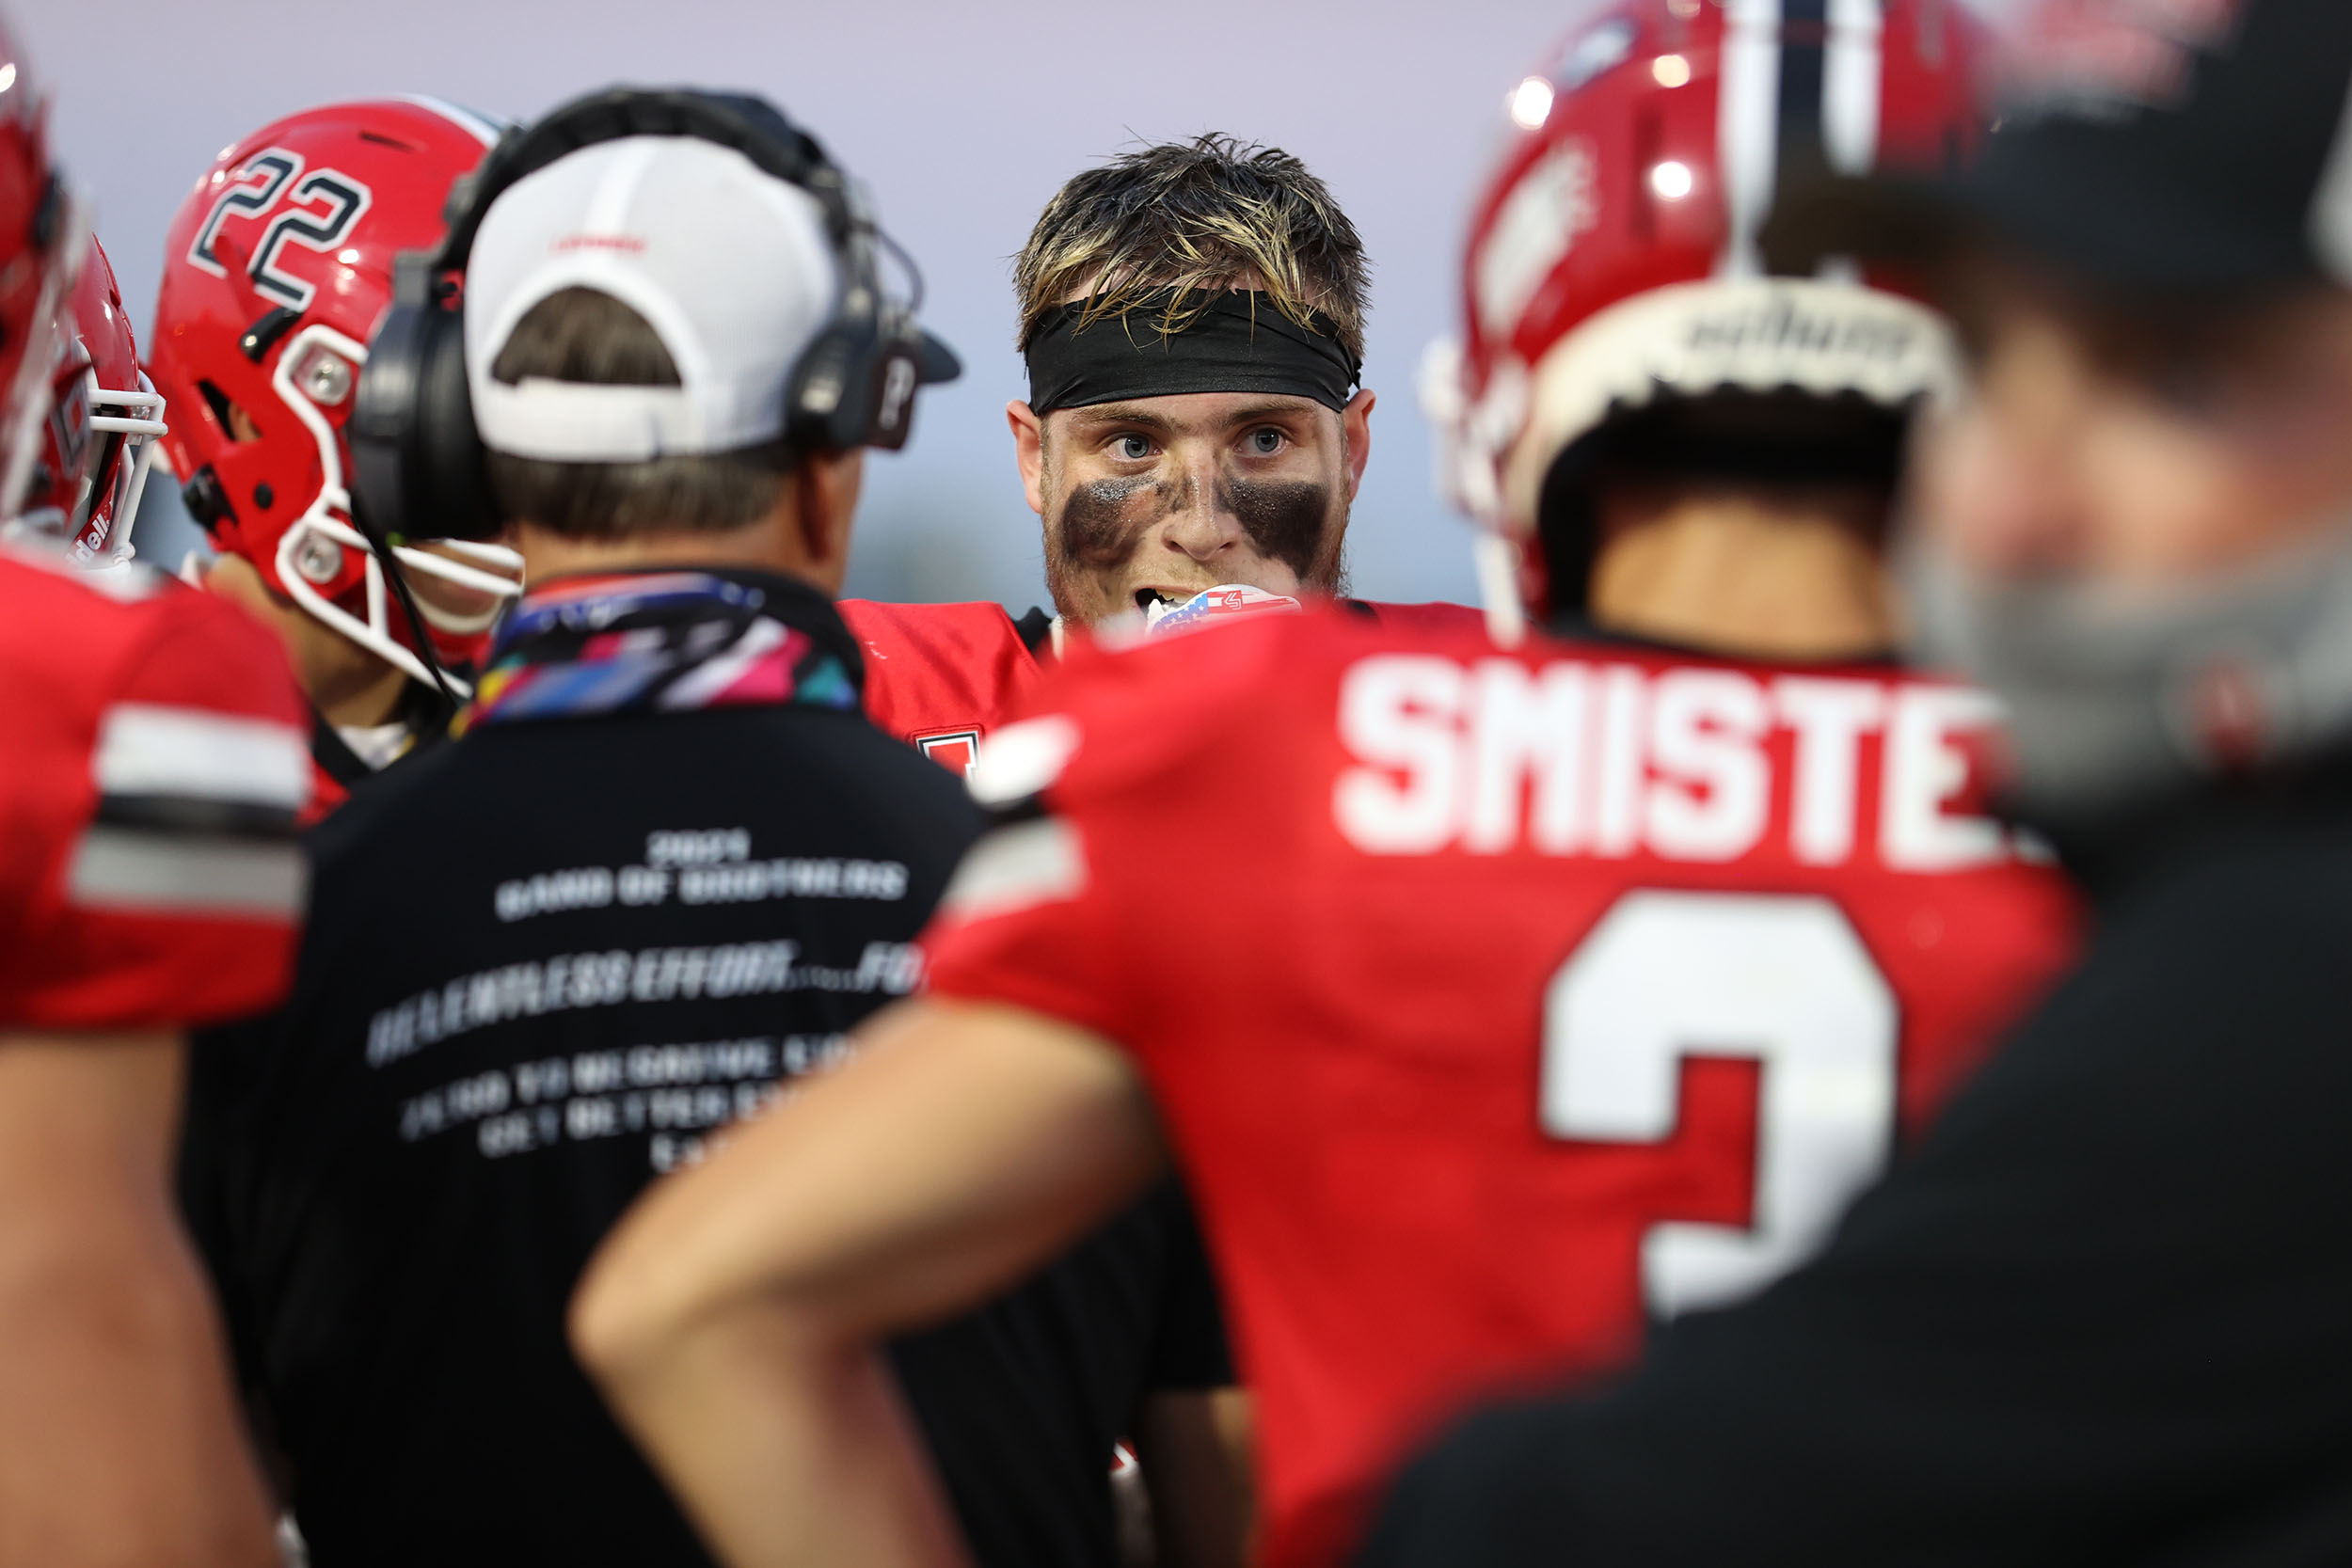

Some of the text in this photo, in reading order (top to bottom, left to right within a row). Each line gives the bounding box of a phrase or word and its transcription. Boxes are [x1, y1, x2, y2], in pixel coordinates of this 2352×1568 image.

[185, 146, 373, 313] 22
[1332, 652, 2060, 873] SMISTE
[496, 857, 909, 922] BAND OF BROTHERS
